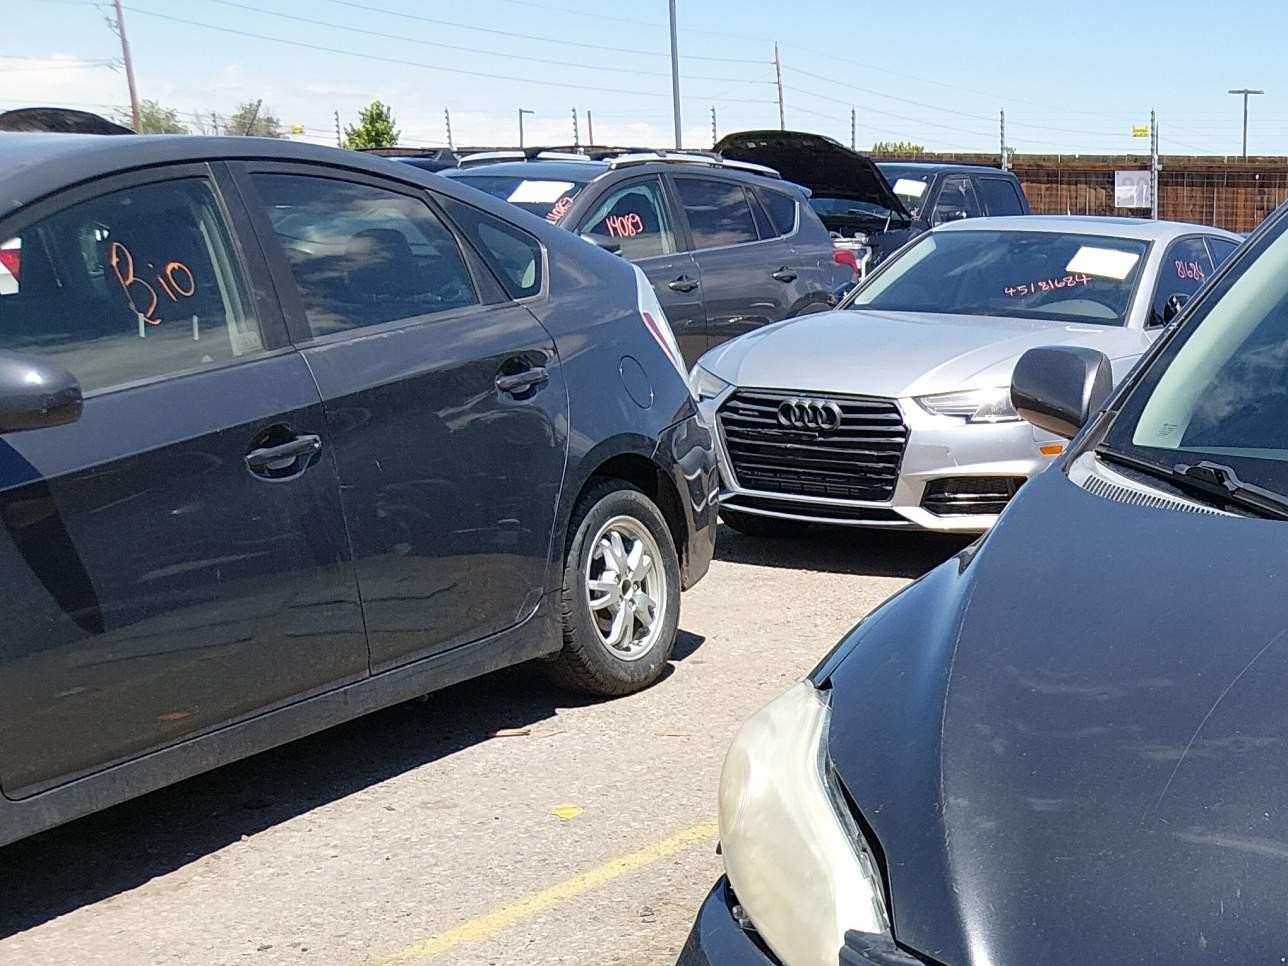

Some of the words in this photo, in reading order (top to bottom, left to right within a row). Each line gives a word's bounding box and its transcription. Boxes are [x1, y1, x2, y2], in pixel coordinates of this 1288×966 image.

[606, 213, 643, 238] 14089
[1175, 260, 1205, 282] 81684
[1005, 274, 1092, 297] 45181684
